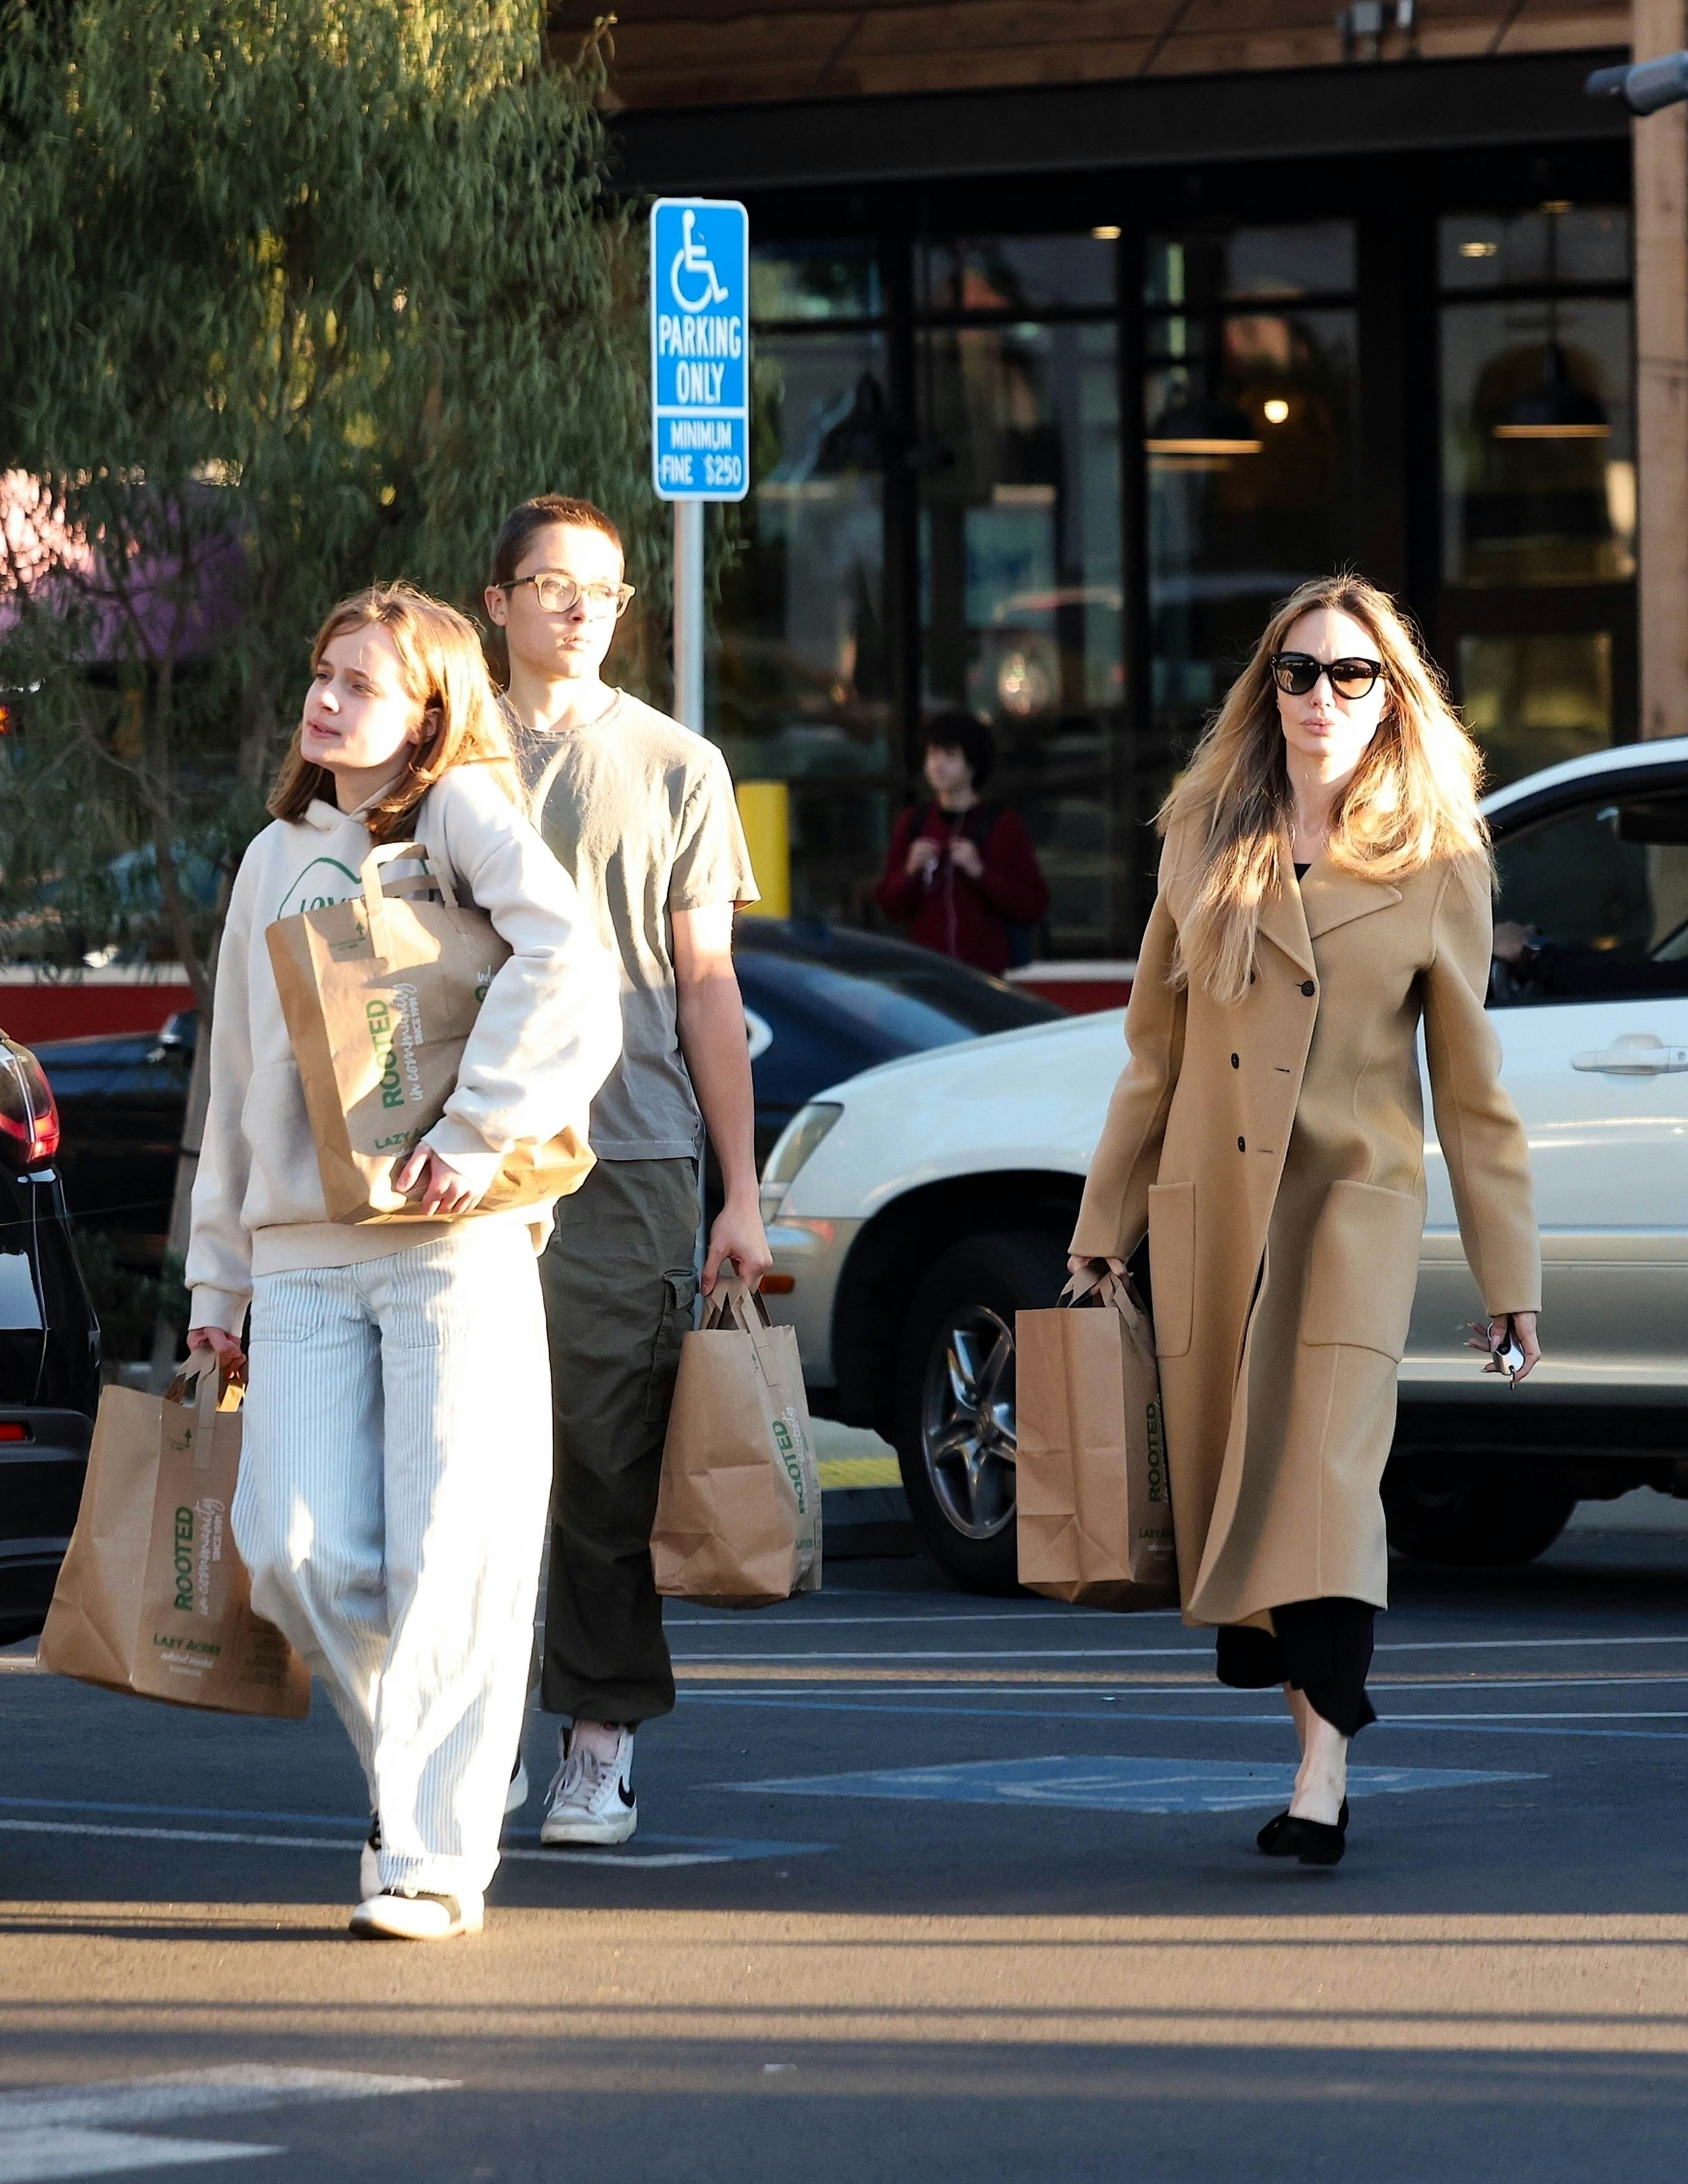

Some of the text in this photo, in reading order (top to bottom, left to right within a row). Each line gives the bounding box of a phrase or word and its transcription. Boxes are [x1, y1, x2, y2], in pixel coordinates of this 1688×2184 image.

[659, 314, 741, 360] PARKING
[676, 360, 724, 405] ONLY
[670, 419, 732, 451] MINIMUM
[660, 453, 742, 486] FINE $250
[366, 998, 404, 1109] ROOTED
[1146, 1402, 1161, 1503] ROOTED
[174, 1506, 193, 1611] ROOTED
